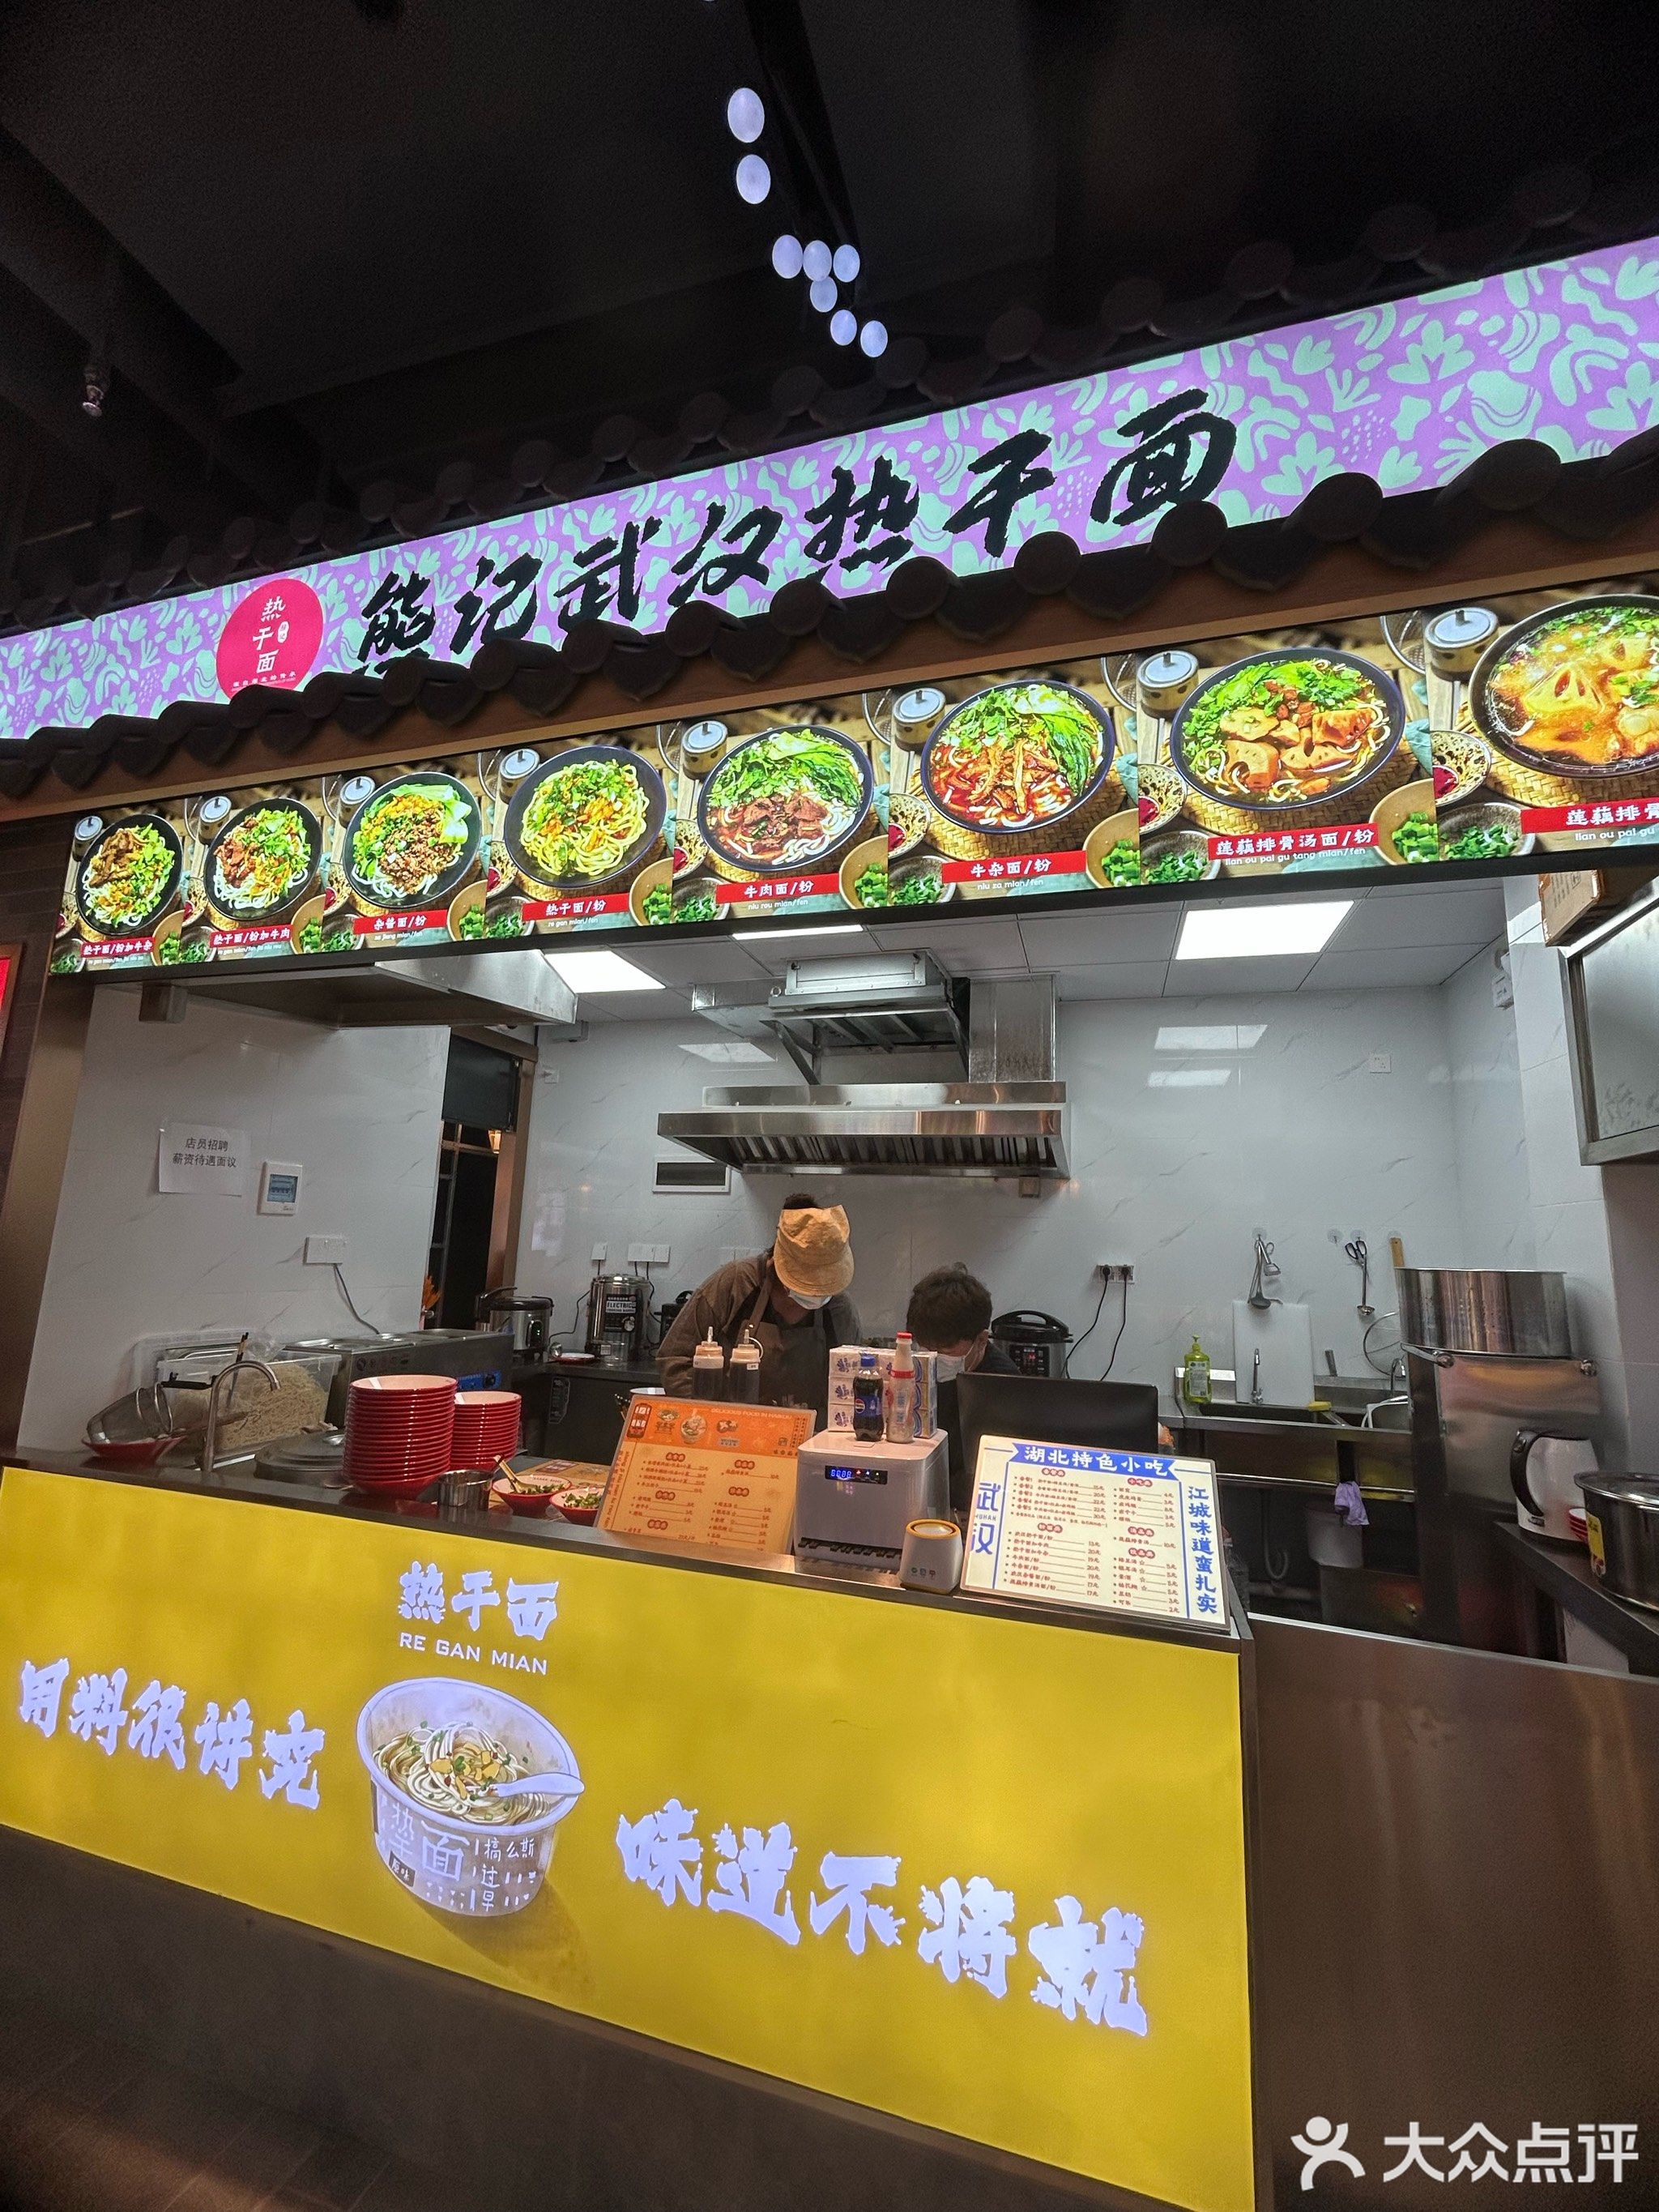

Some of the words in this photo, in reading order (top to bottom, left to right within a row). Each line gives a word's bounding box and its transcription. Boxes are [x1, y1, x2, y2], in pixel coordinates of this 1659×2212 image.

[253, 596, 286, 673] 热干面
[1216, 829, 1374, 856] 莲藕排骨汤面/粉
[1575, 833, 1596, 841] lian
[1618, 828, 1636, 839] pai
[1640, 827, 1655, 838] gu
[1226, 857, 1243, 865] lian
[1260, 855, 1275, 864] pai
[1277, 854, 1290, 863] gu
[1293, 852, 1316, 861] tang
[1318, 848, 1366, 858] mian/fen
[970, 859, 1052, 878] 牛杂面/粉
[744, 881, 814, 898] 牛肉面/粉
[977, 882, 990, 890] niu
[546, 900, 607, 916] 热干面/粉
[373, 915, 427, 931] 杂酱面/粉
[83, 939, 152, 955] 热干面/粉加牛杂
[213, 928, 291, 946] 热干面/粉加牛肉
[185, 1137, 228, 1152] 店员招聘
[173, 1153, 237, 1168] 薪资待遇面议
[1025, 1446, 1169, 1477] 湖北特色小吃
[1188, 1486, 1218, 1615] 江城味道蛮扎实
[398, 1561, 559, 1640] 热干面
[400, 1633, 427, 1653] RE
[437, 1638, 480, 1663] GAN
[492, 1650, 548, 1675] MIAN
[20, 1659, 326, 1809] 用料很讲究
[484, 1837, 535, 1862] 搞么斯
[391, 1861, 411, 1881] 原味
[480, 1864, 501, 1888] 过
[482, 1890, 495, 1911] 早
[616, 1799, 1147, 2035] 味道不将就
